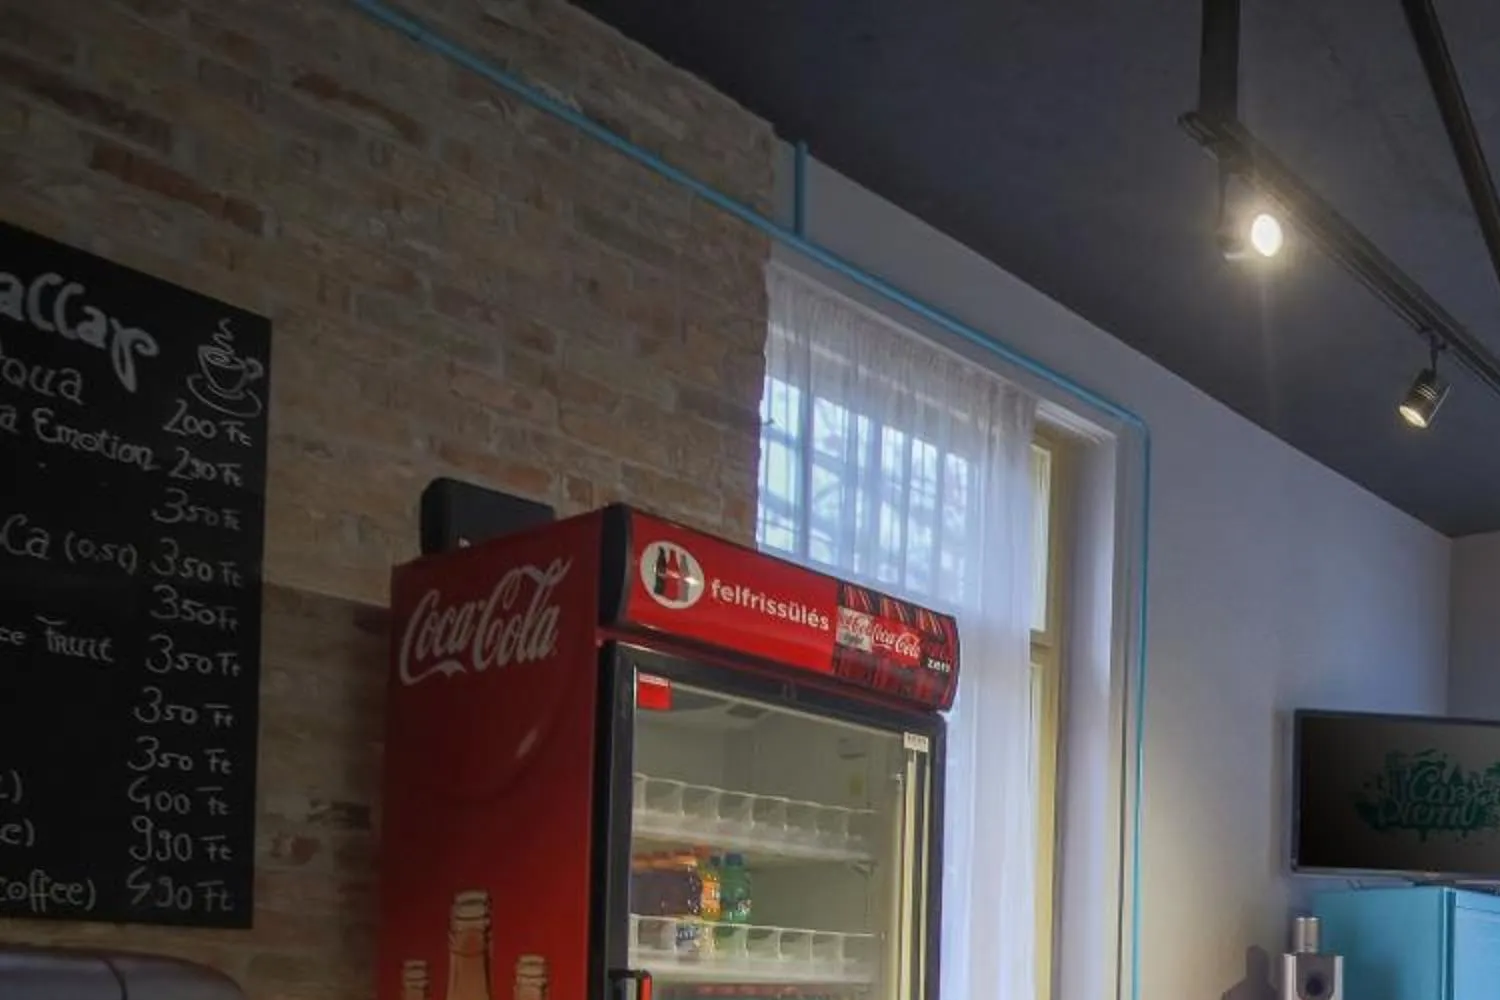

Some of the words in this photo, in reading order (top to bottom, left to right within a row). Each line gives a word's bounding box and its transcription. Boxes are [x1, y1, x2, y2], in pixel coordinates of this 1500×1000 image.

[163, 399, 217, 437] 200
[32, 407, 161, 471] Emotion
[151, 537, 213, 578] 350
[151, 584, 216, 625] 350
[399, 554, 573, 686] Coca-Cola
[711, 578, 830, 631] felfrissülés
[146, 634, 213, 674] 350
[134, 686, 199, 723] 350
[128, 736, 194, 772] 350
